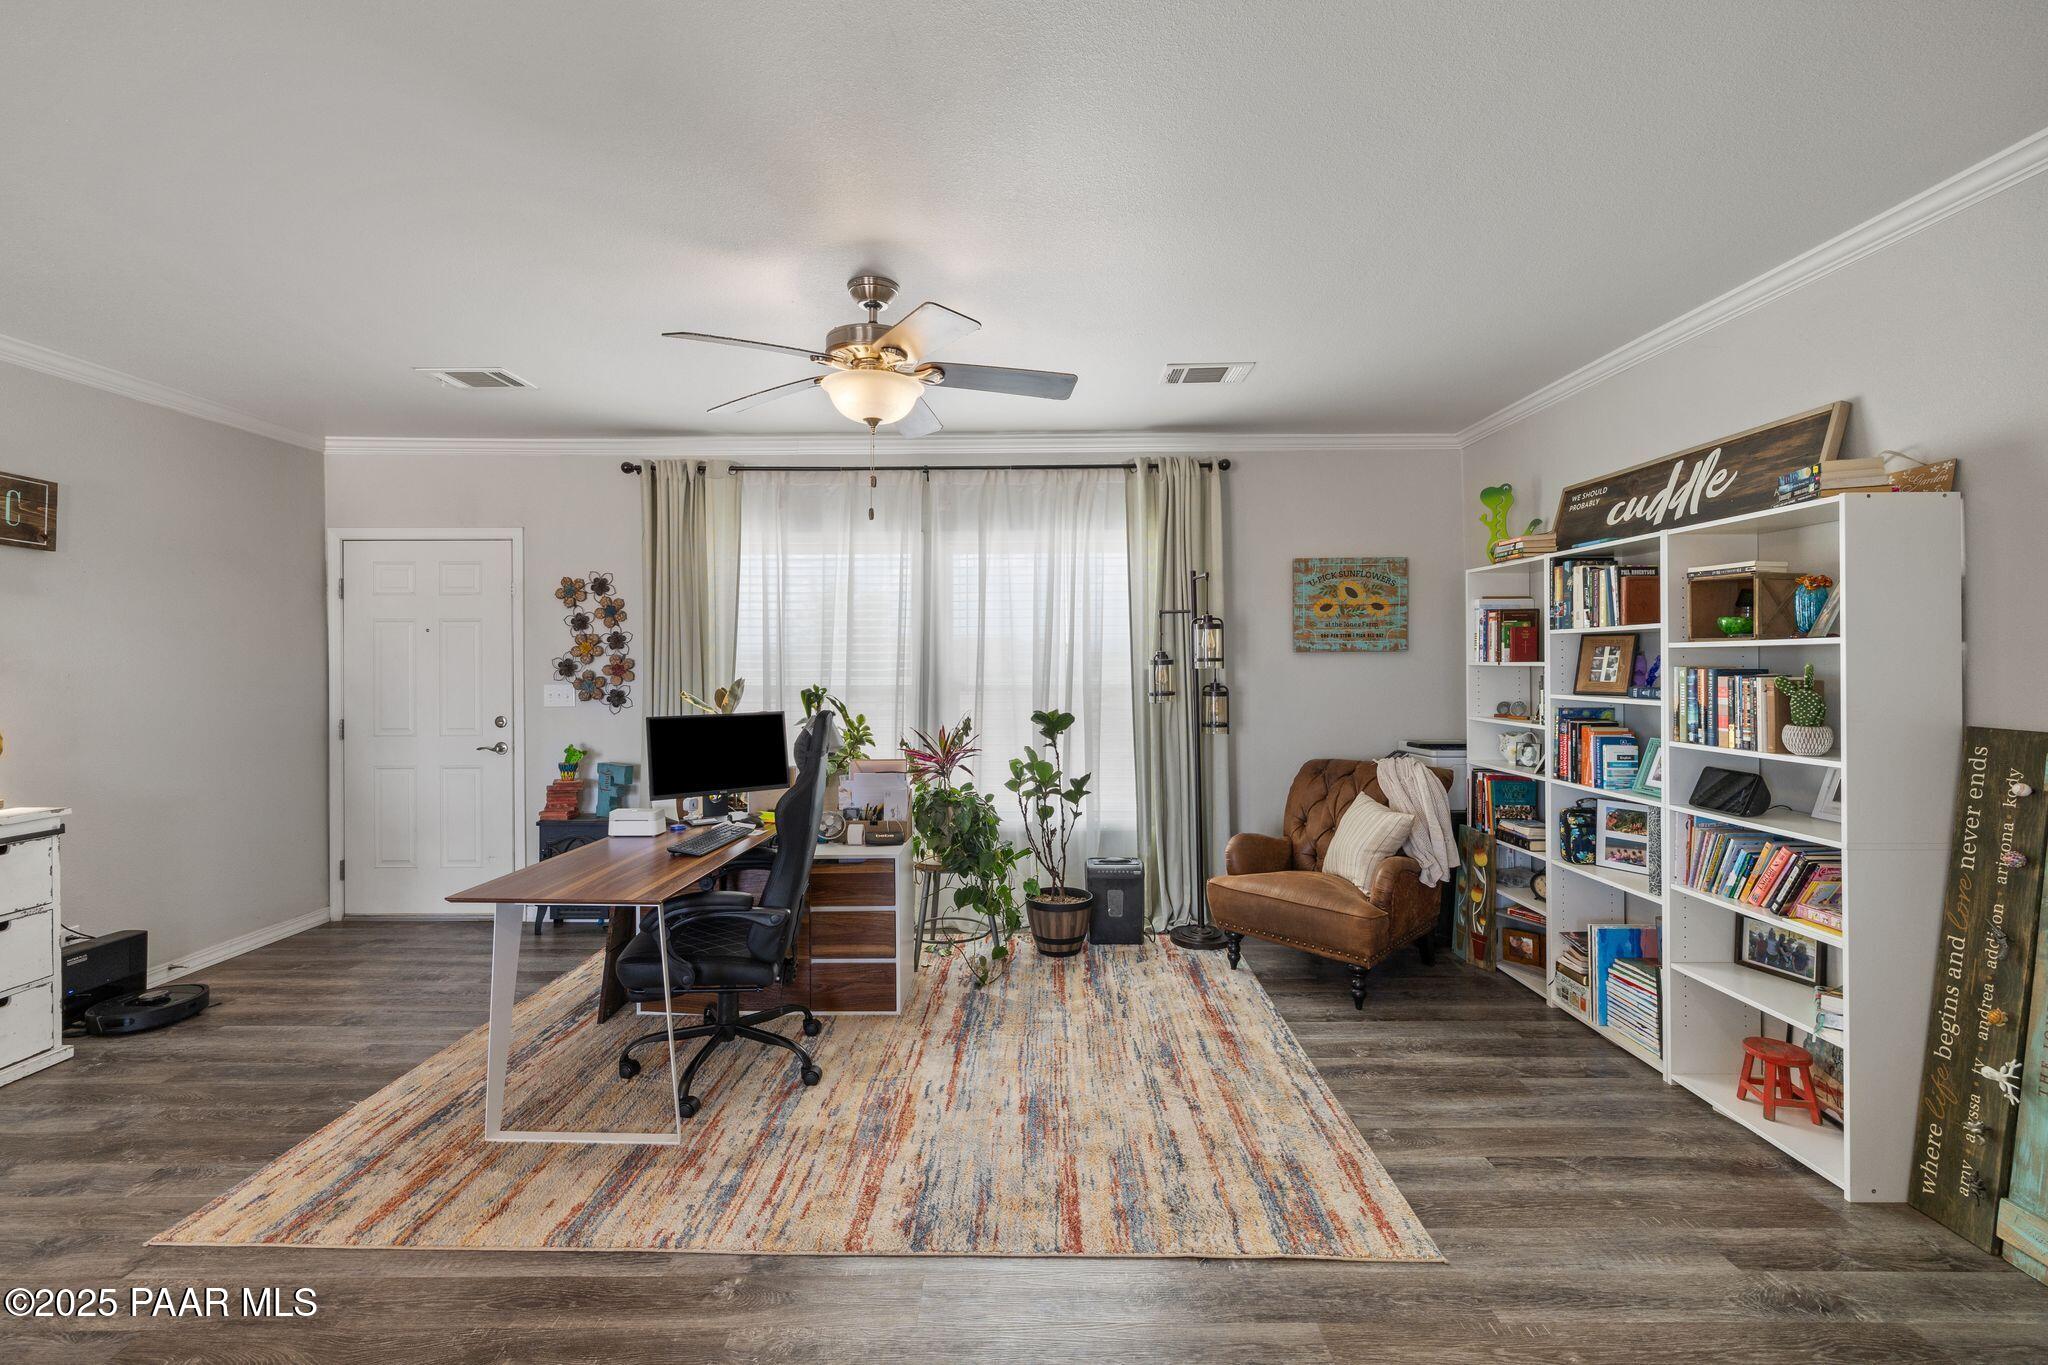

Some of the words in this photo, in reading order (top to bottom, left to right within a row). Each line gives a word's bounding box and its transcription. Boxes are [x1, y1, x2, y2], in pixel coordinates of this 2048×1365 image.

[1568, 497, 1601, 512] PROBABLY
[1571, 494, 1582, 502] WE
[1582, 486, 1608, 499] SHOULD
[1606, 447, 1738, 526] cuddle
[1908, 470, 1950, 488] Garden
[1308, 571, 1338, 587] U-PICK
[1338, 570, 1397, 587] SUNFLOWERS
[1968, 746, 1989, 800] ends
[1960, 805, 1981, 871] never
[1945, 873, 1972, 932] love
[1947, 935, 1966, 980] and
[1985, 903, 2004, 970] addion
[1933, 985, 1961, 1061] begins
[1978, 983, 1994, 1041] andrea
[1924, 1063, 1958, 1120] life
[1919, 1123, 1943, 1196] where
